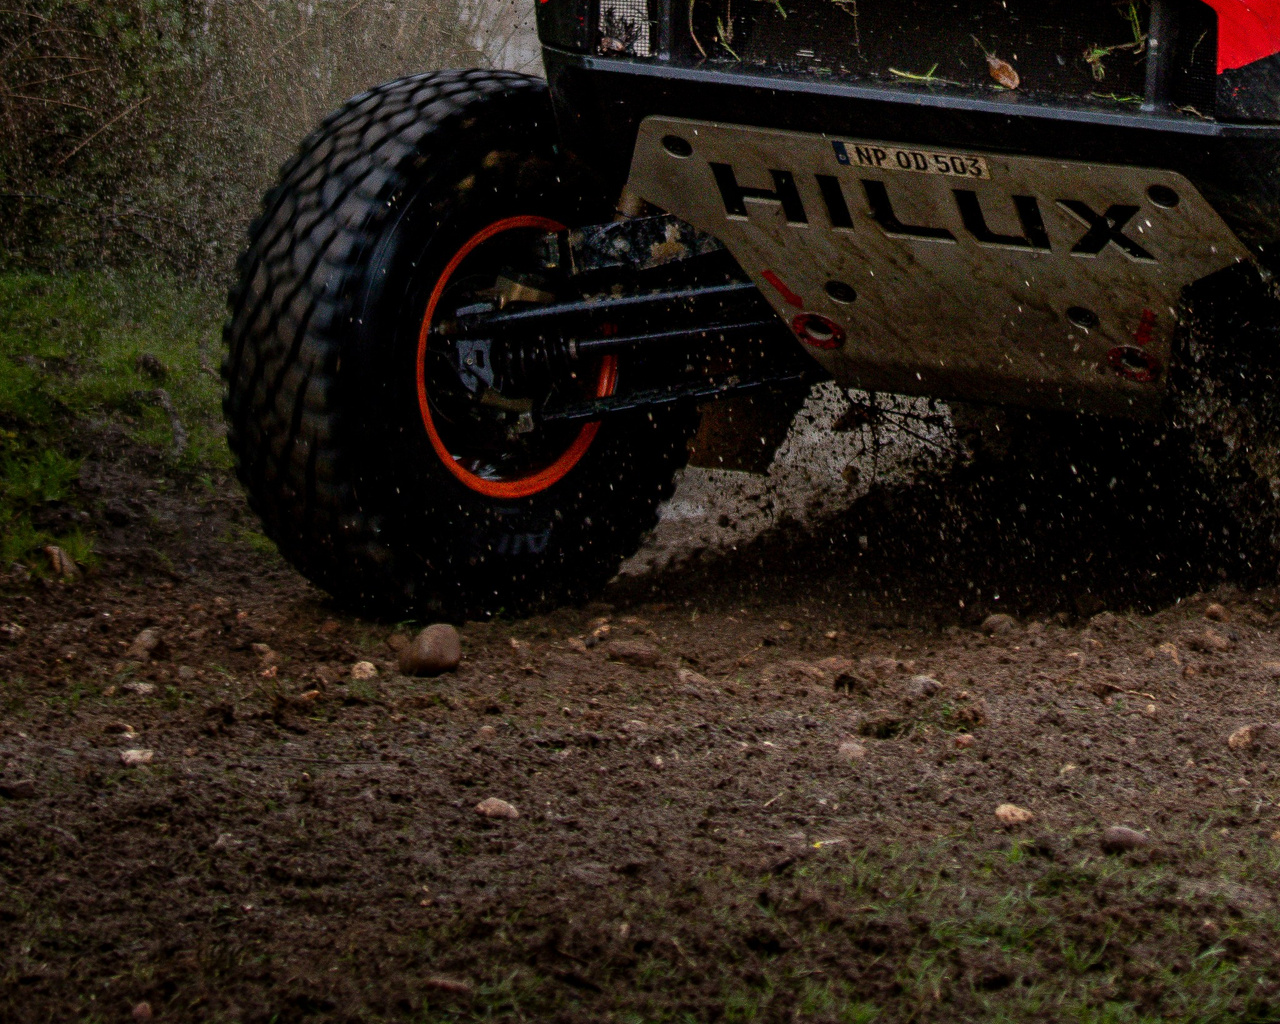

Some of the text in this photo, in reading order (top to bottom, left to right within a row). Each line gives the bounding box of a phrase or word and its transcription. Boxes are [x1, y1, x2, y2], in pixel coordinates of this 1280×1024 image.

[855, 146, 887, 166] NP
[896, 151, 928, 171] OD
[934, 155, 982, 177] 503
[709, 162, 1160, 264] HILUX
